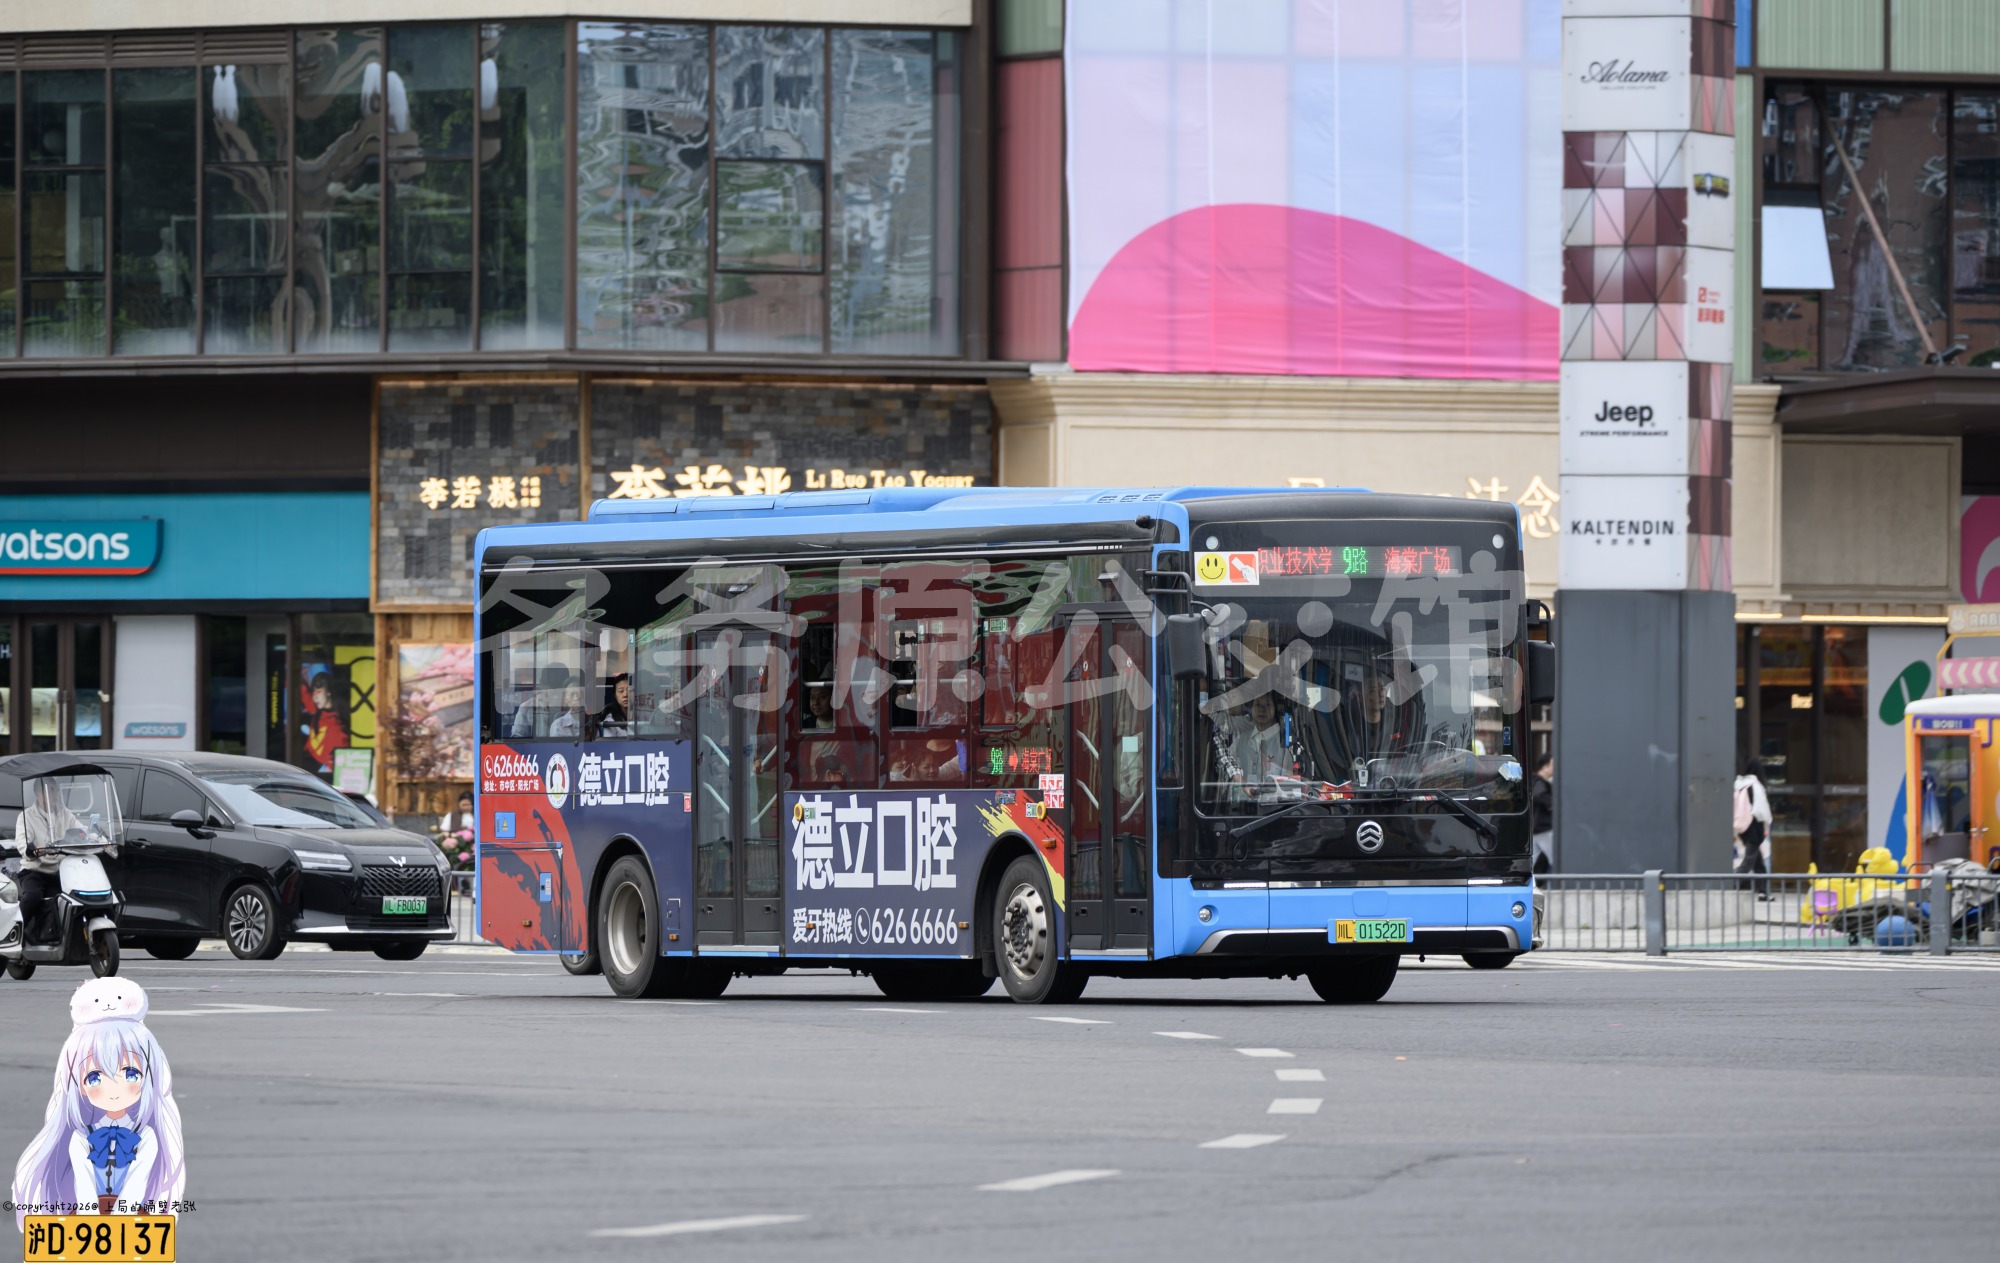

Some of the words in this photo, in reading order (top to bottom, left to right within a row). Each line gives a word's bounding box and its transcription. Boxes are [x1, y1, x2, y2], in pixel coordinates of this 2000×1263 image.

[1595, 400, 1653, 427] Jeep
[1571, 520, 1674, 535] KALTENDIN
[1343, 546, 1369, 575] 9路
[1384, 546, 1451, 574] 海棠广场
[1970, 613, 2000, 627] RAB
[578, 751, 670, 806] 德立口腔
[792, 794, 958, 892] 德立口腔
[793, 907, 852, 944] 爱牙热线
